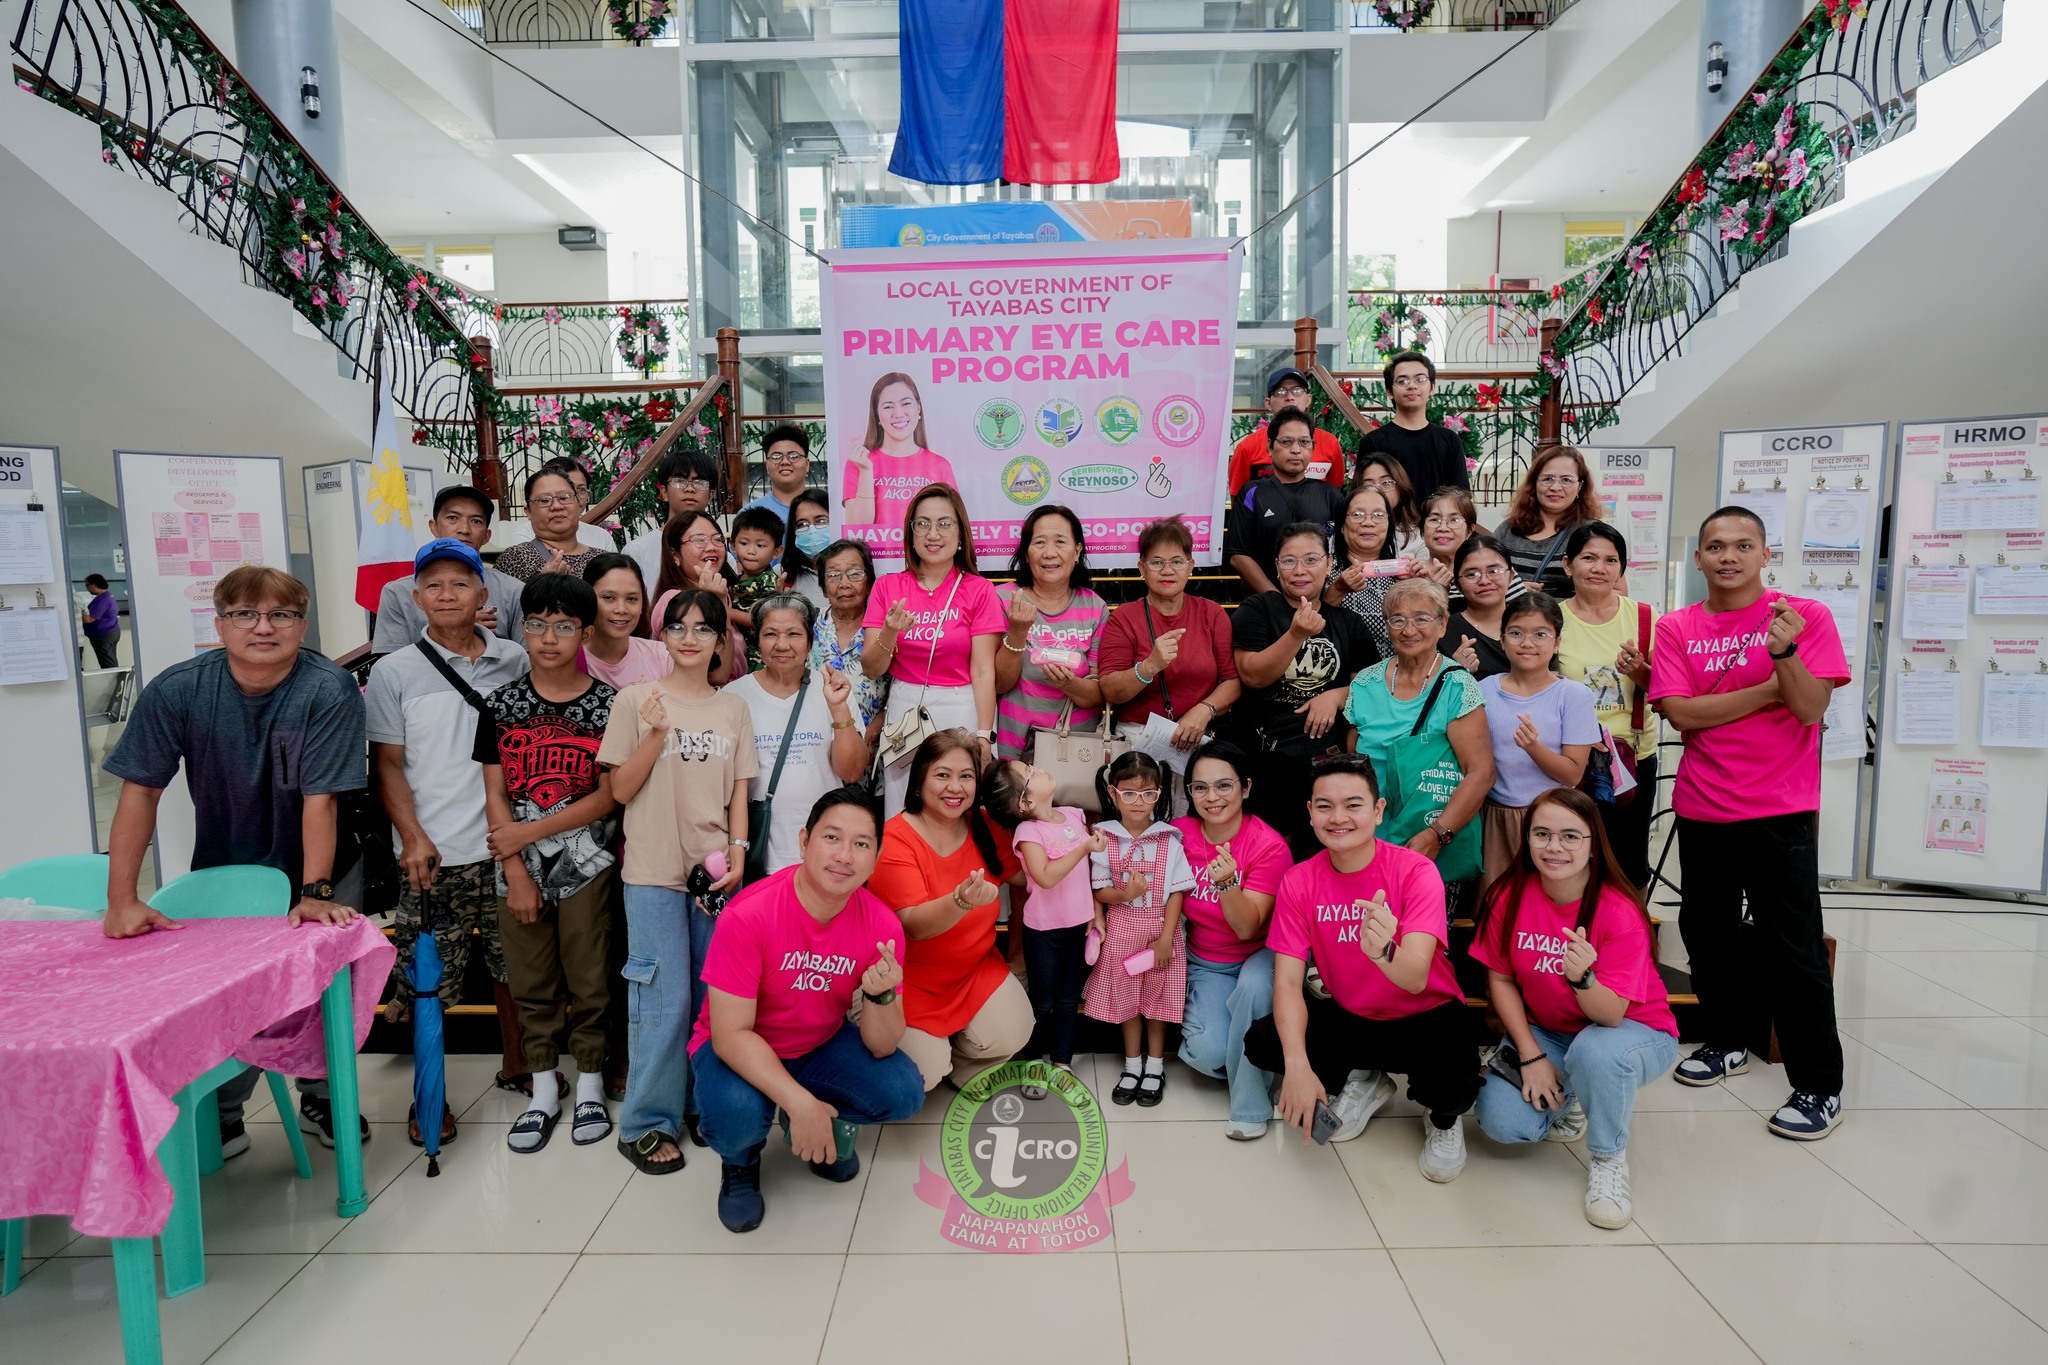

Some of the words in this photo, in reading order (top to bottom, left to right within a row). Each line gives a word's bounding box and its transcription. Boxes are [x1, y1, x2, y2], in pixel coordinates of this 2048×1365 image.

[926, 234, 942, 242] City
[943, 232, 991, 241] Government
[1001, 231, 1034, 241] Tayabas
[887, 281, 963, 299] LOCAL
[968, 275, 1135, 297] GOVERNMENT
[1141, 274, 1173, 291] OF
[947, 298, 1053, 317] TAYABAS
[1060, 297, 1111, 314] CITY
[842, 324, 1020, 357] PRIMARY
[1031, 322, 1103, 351] EYE
[1115, 319, 1221, 347] CARE
[931, 352, 1130, 383] PROGRAM
[1954, 426, 2026, 444] HRMO
[1771, 435, 1833, 452] CCRO
[168, 457, 234, 466] COOPERATIVE
[1607, 455, 1642, 467] PESO
[168, 468, 237, 477] DEVELOPMENT
[322, 472, 332, 480] CITY
[1072, 466, 1123, 476] SERBISYONG
[316, 480, 342, 490] ENGINEERING
[1068, 476, 1128, 486] REYNOSO
[883, 488, 912, 500] AKO
[847, 527, 904, 542] MAYO
[904, 626, 936, 641] AKO
[1686, 632, 1768, 655] TAYABASIN
[776, 732, 824, 742] PTORAL
[1438, 761, 1454, 769] MAYOR
[780, 950, 857, 976] TAYABASIN
[790, 972, 825, 992] AKO
